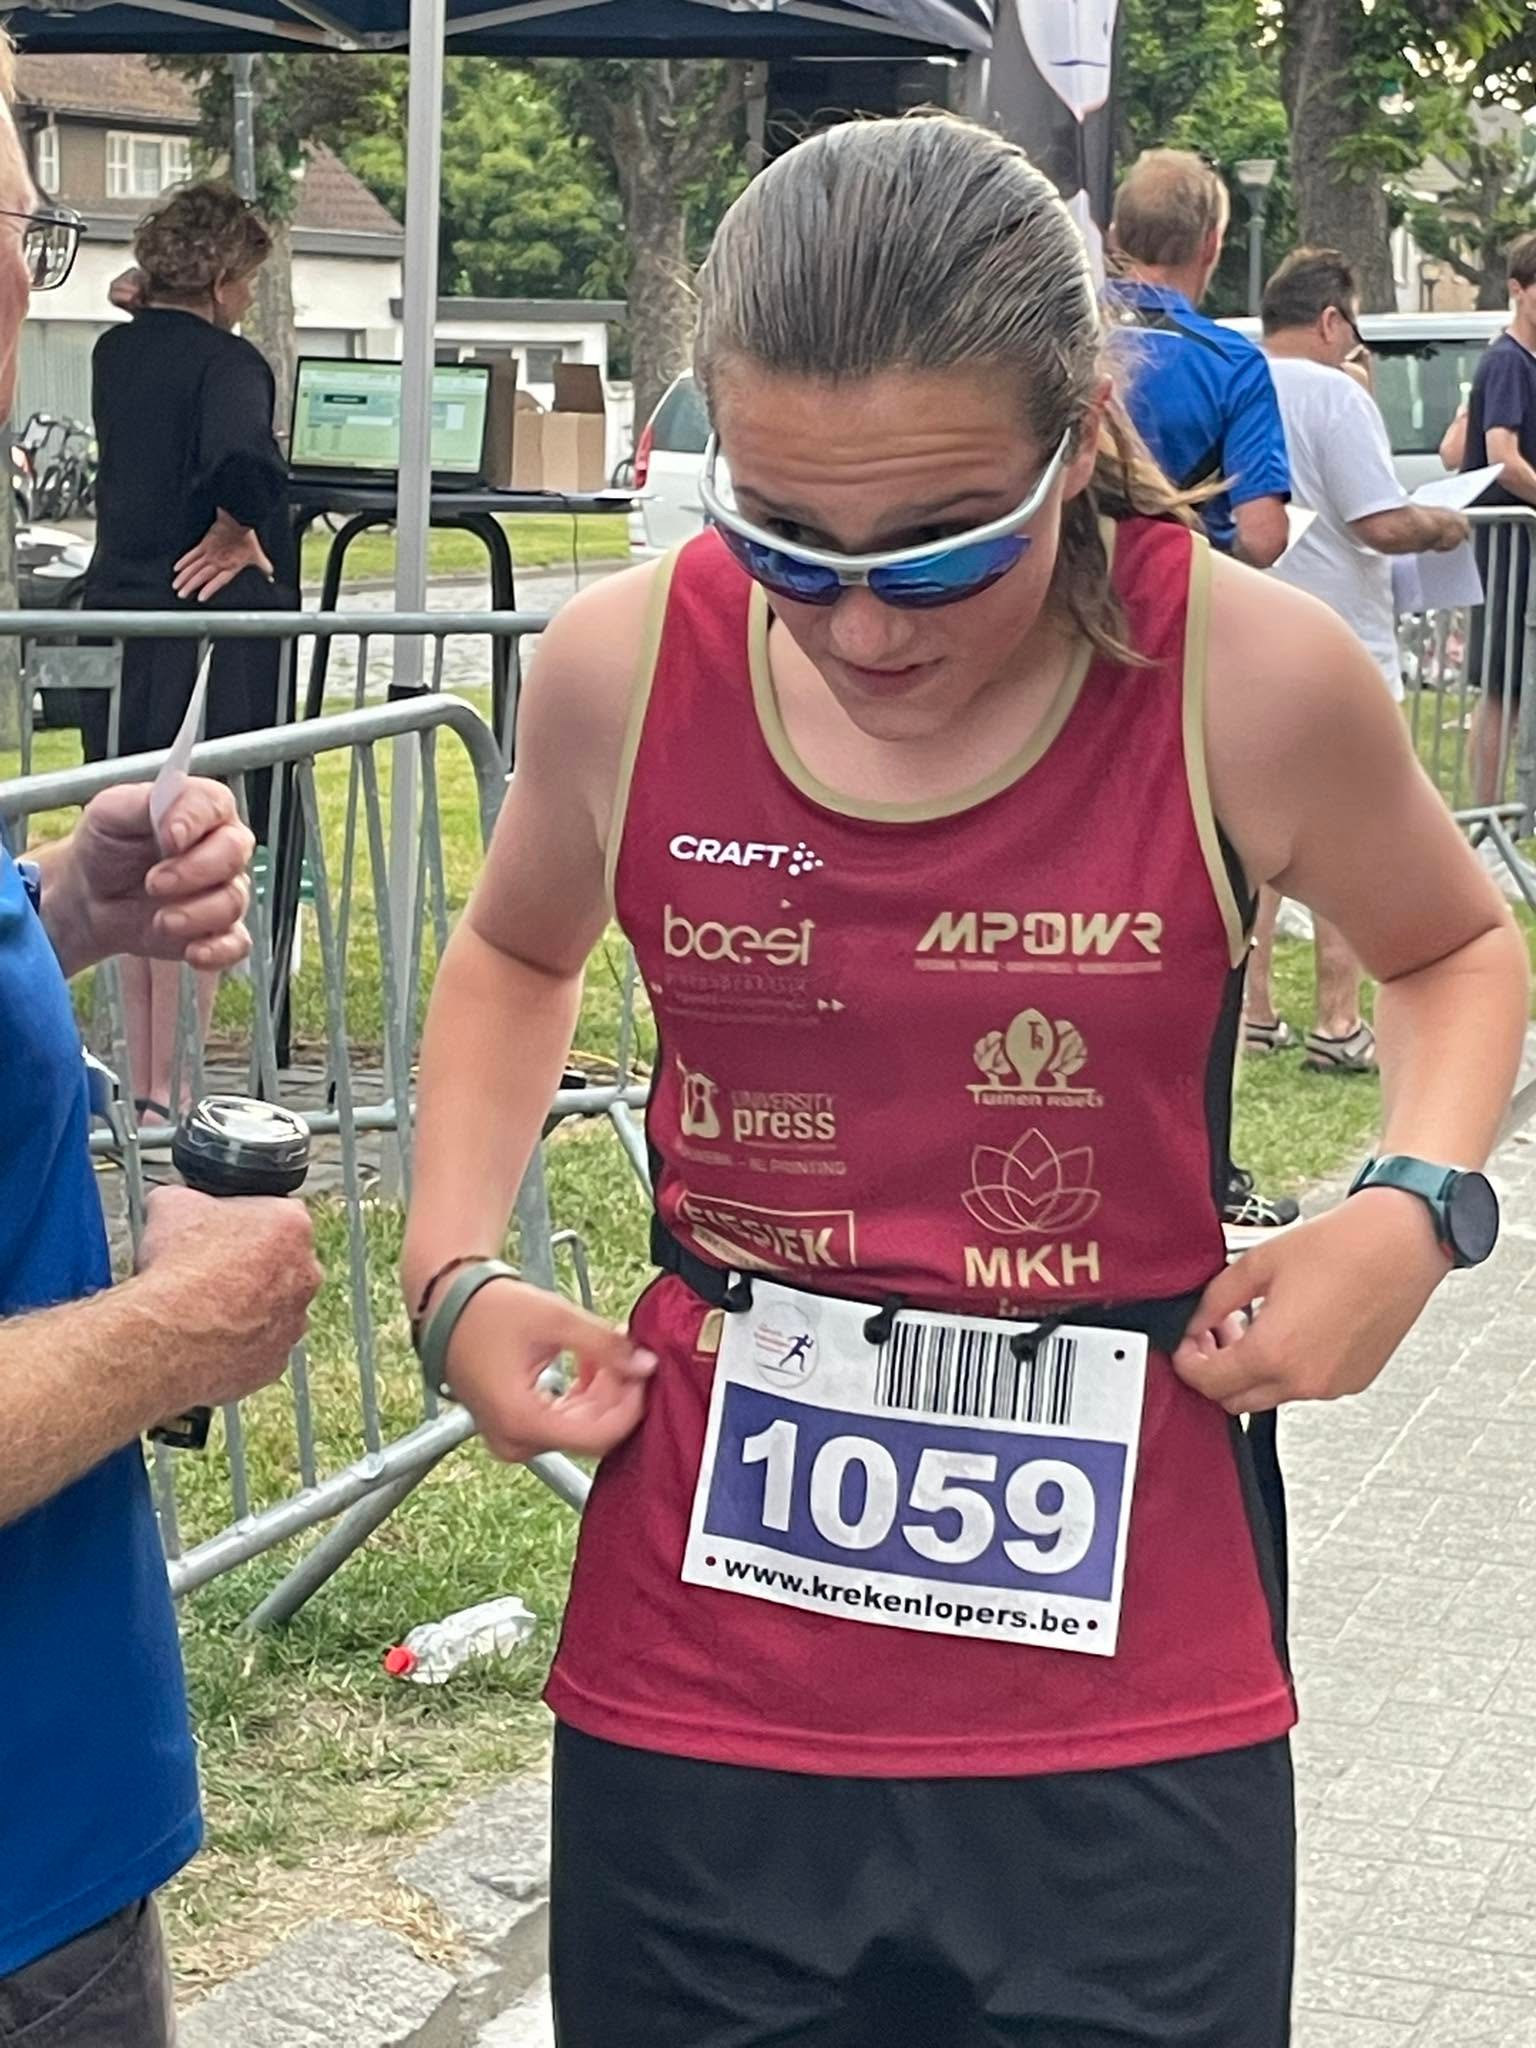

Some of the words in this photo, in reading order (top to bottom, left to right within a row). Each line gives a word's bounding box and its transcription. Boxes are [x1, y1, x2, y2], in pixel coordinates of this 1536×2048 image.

[669, 835, 789, 868] CRAFT
[915, 911, 1163, 956] MPOWR
[734, 1108, 837, 1143] press
[963, 1241, 1101, 1289] MKH
[742, 1419, 1097, 1574] 1059
[725, 1557, 1080, 1635] www.krekenlopers.be
